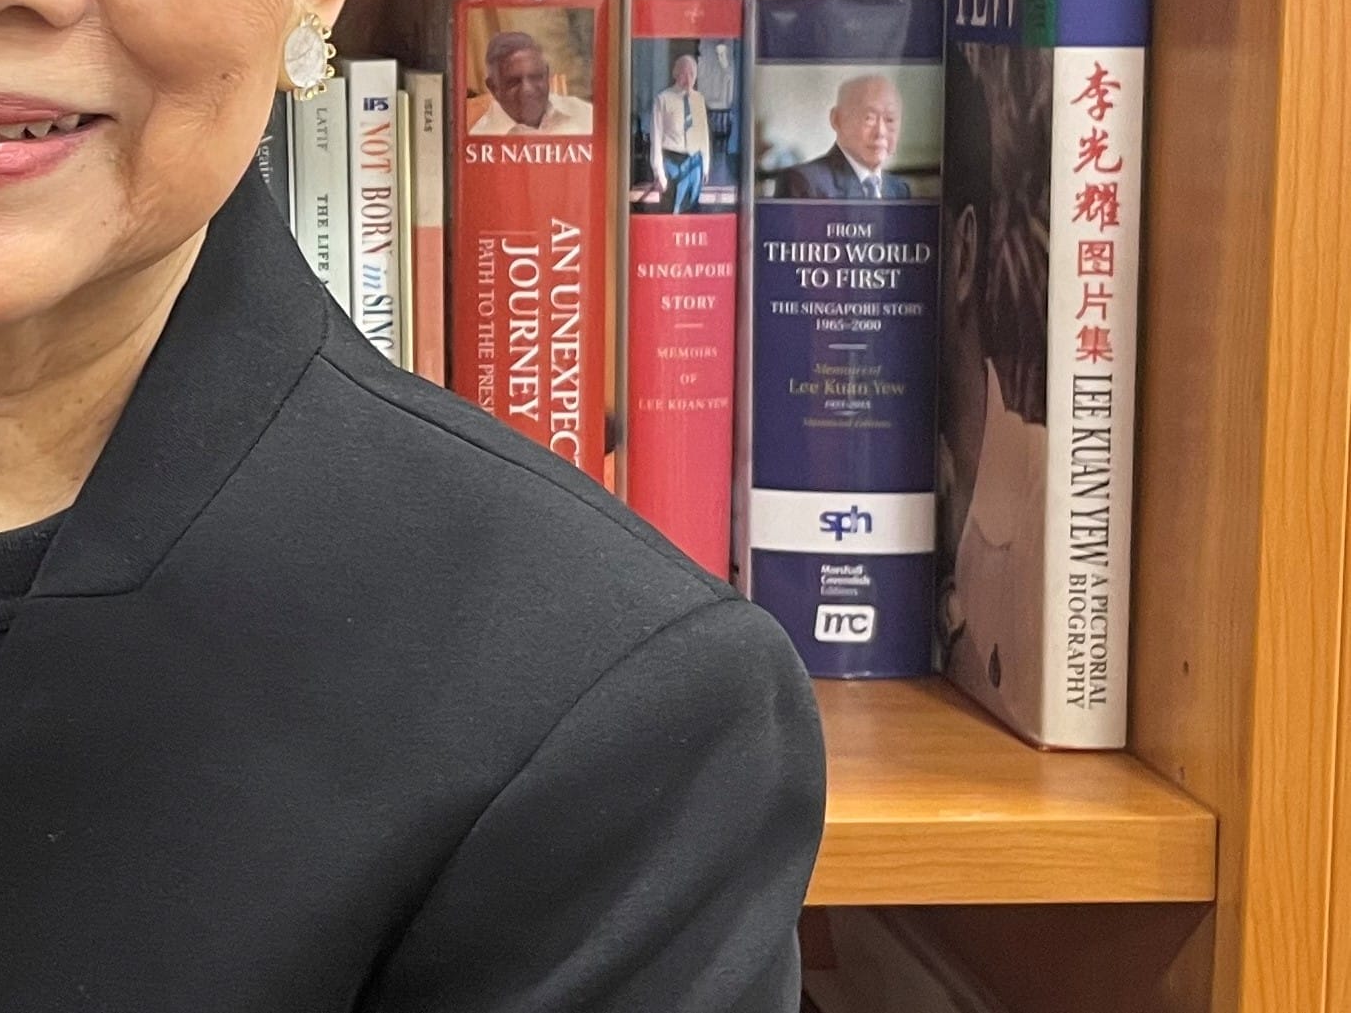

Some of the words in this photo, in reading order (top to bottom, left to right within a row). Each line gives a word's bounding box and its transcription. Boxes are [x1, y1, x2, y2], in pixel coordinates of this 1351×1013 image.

[315, 106, 329, 152] LATIF
[423, 98, 434, 134] ISEAS
[360, 120, 392, 174] NOT
[465, 144, 478, 163] S
[481, 144, 496, 162] R
[500, 143, 594, 164] NATHAN
[316, 194, 330, 230] THE
[360, 184, 394, 256] BORN
[550, 217, 582, 273] AN
[672, 231, 708, 247] THE
[826, 223, 872, 239] FROM
[316, 234, 330, 273] LIFE
[477, 237, 496, 285] PATH
[637, 262, 734, 279] SINGAPORE
[764, 243, 847, 264] THIRD
[846, 243, 932, 264] WORLD
[362, 260, 384, 292] in
[796, 268, 831, 289] TO
[835, 269, 901, 289] FIRST
[477, 291, 496, 317] TO
[660, 294, 716, 310] STORY
[770, 301, 799, 315] THE
[801, 301, 881, 316] SINGAPORE
[882, 302, 924, 315] STORY
[477, 320, 496, 359] THE
[500, 237, 542, 423] JOURNEY
[656, 346, 718, 359] MEMOIRS
[679, 372, 698, 385] OF
[789, 378, 820, 394] Lee
[823, 379, 868, 396] Kuan
[872, 379, 906, 395] Yew
[1070, 373, 1113, 420] LEE
[638, 397, 665, 410] LEE
[667, 397, 706, 411] KUAN
[707, 397, 729, 410] YEW
[1069, 425, 1113, 498] KUAN
[819, 505, 873, 541] sph
[1068, 503, 1111, 569] YEW
[1090, 573, 1108, 588] A
[1066, 572, 1088, 711] BIOGRAPHY
[1088, 593, 1109, 710] PICTORIAL
